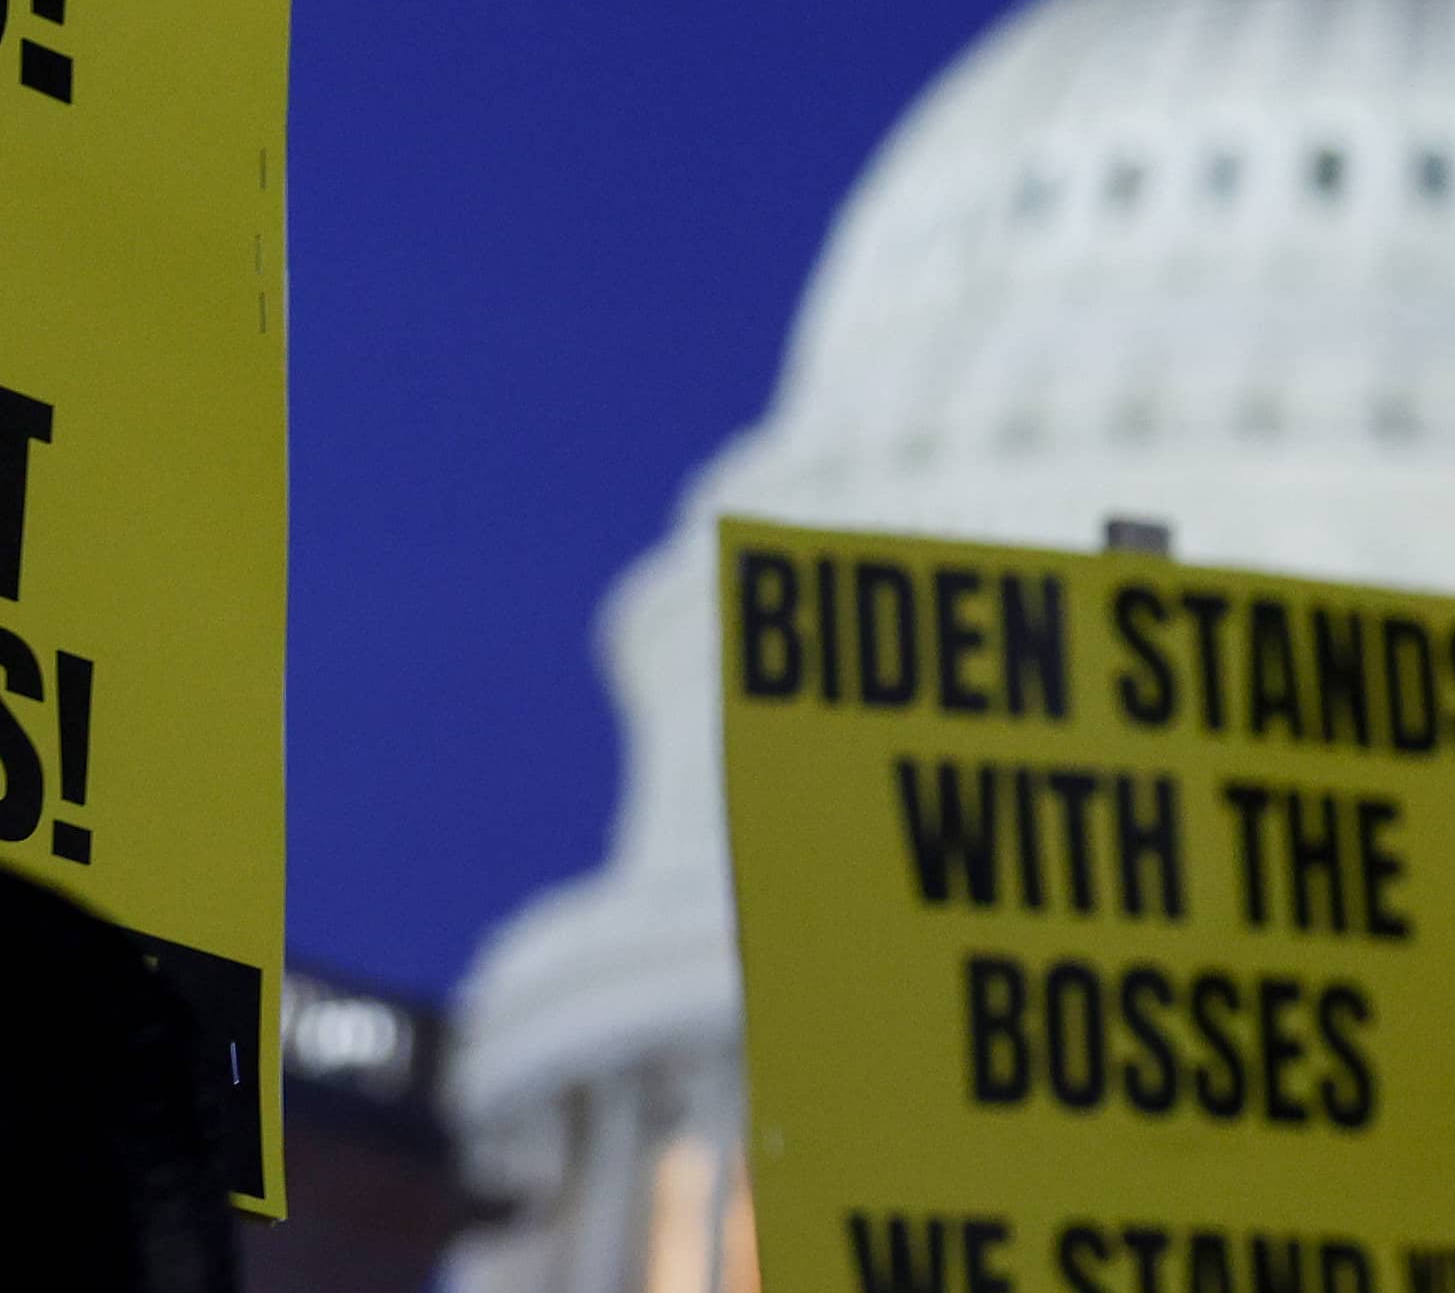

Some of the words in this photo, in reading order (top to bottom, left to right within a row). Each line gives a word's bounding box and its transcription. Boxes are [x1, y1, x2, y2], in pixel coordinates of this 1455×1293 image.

[738, 551, 1068, 720] BIDEN
[896, 755, 1186, 919] WITH
[1222, 783, 1411, 942] THE
[968, 955, 1373, 1130] BOSSES
